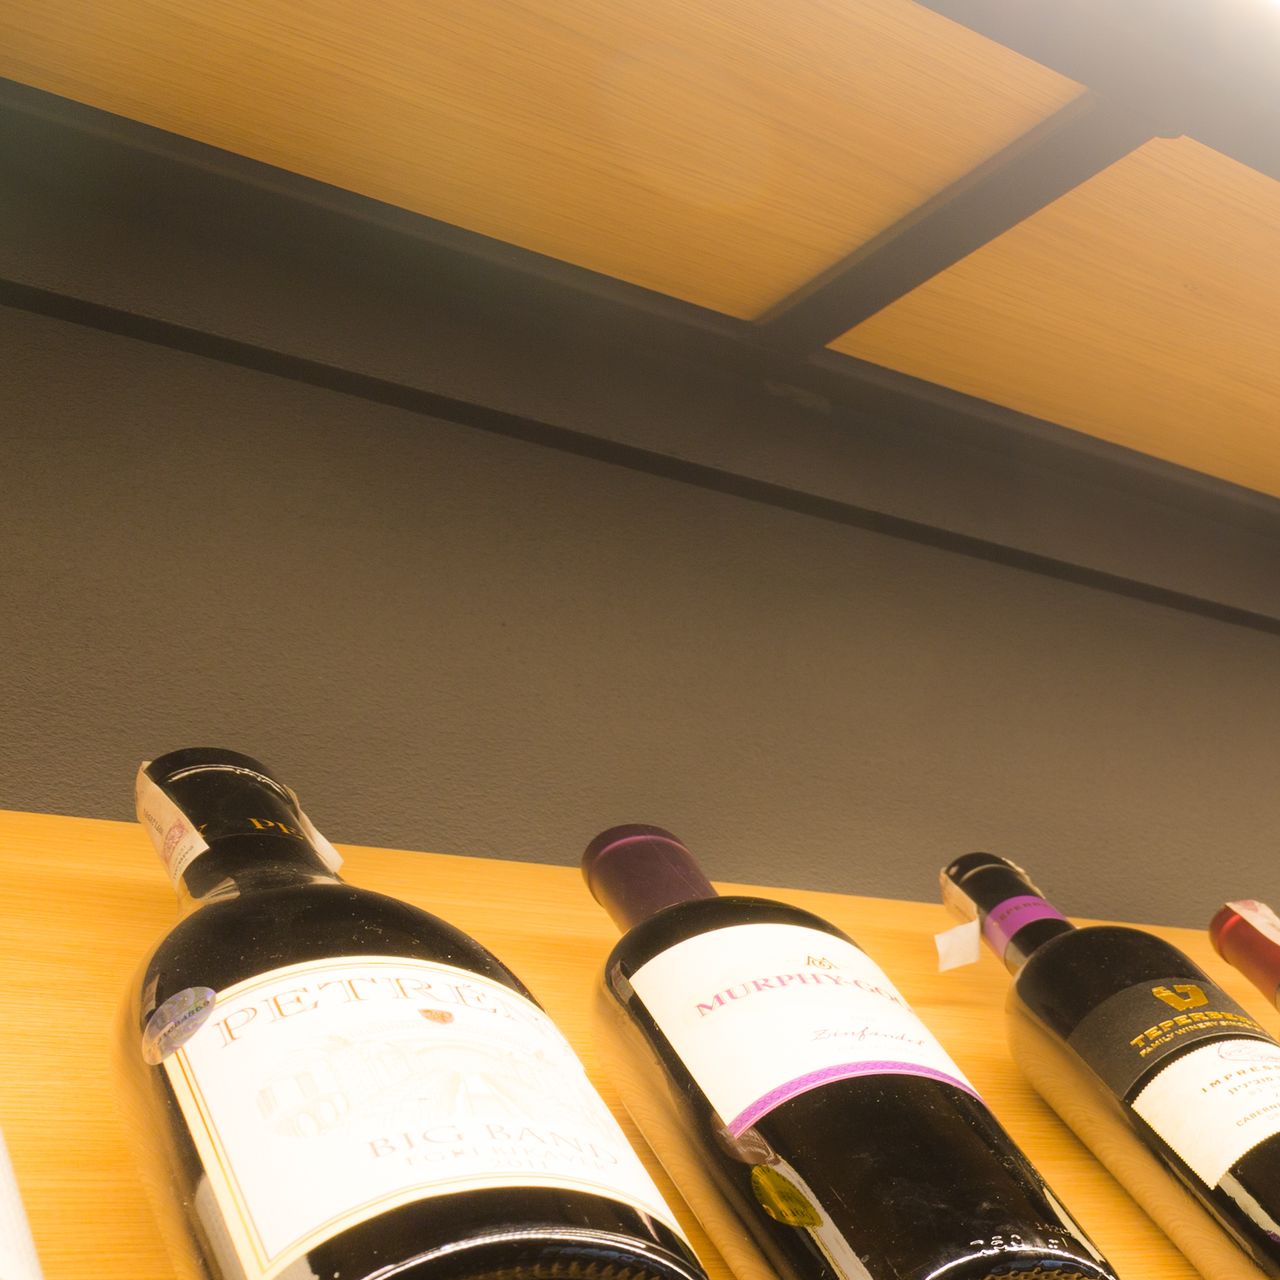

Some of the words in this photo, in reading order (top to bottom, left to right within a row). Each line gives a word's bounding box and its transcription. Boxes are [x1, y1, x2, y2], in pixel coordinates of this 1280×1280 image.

[1139, 1031, 1175, 1057] FAMILY
[1177, 1020, 1218, 1037] WINERY
[368, 1124, 464, 1159] BIG
[485, 1123, 619, 1166] BAND
